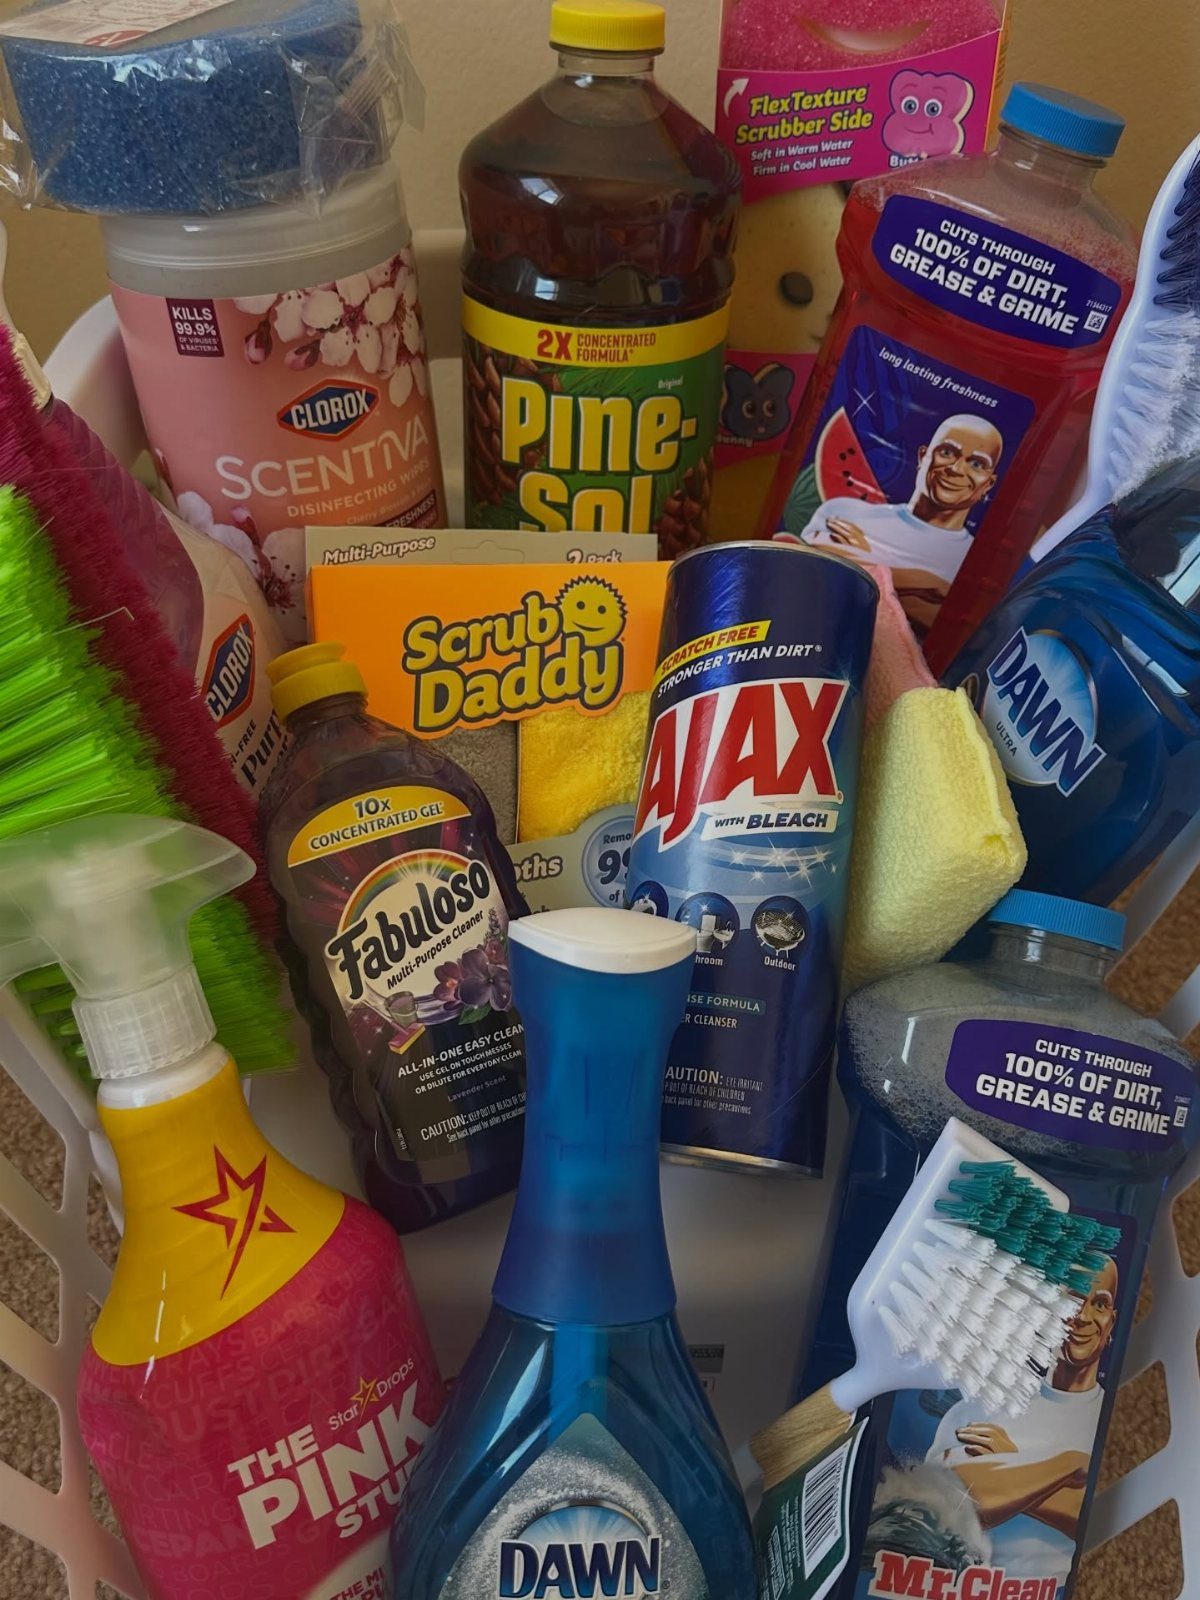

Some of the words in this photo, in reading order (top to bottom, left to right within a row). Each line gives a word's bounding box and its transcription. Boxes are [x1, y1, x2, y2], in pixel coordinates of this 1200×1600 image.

[736, 117, 826, 144] Scrubber
[829, 108, 873, 132] Side
[751, 147, 772, 161] Soft
[775, 147, 785, 157] in
[788, 144, 818, 156] Warm
[821, 140, 853, 152] Water
[753, 166, 776, 176] Firm
[780, 163, 790, 172] in
[793, 158, 816, 171] Cool
[820, 156, 851, 168] Water
[915, 227, 969, 269] 100%
[972, 255, 1006, 280] OF
[1007, 268, 1067, 309] DIRT,
[940, 219, 979, 246] CUTS
[981, 232, 1056, 275] THROUGH
[889, 243, 982, 297] GREASE
[977, 285, 996, 306] &
[998, 291, 1079, 335] GRIME
[172, 306, 212, 321] KILLS
[175, 322, 217, 336] 99.9%
[186, 344, 218, 352] BACTERIA
[537, 329, 573, 360] 2X
[577, 333, 656, 349] CONCENTRATED
[878, 347, 901, 370] long
[902, 359, 941, 387] lasting
[941, 376, 998, 409] freshness
[291, 389, 370, 431] CLOROX
[215, 415, 429, 501] SCENTIVA
[287, 479, 397, 518] DISINFECTING
[400, 459, 430, 485] WIPES
[323, 536, 436, 566] Multi-Purpose
[405, 594, 561, 669] Scrub
[661, 636, 715, 676] SCRATCH
[716, 626, 760, 646] FREE
[205, 623, 253, 722] CLOROX
[416, 635, 622, 731] Daddy
[657, 655, 724, 698] STRONGER
[726, 645, 773, 664] THAN
[988, 628, 1105, 795] DAWN
[996, 721, 1017, 757] ULTRA
[634, 681, 846, 846] AJAX
[355, 797, 392, 818] 10x
[714, 816, 744, 829] WITH
[746, 812, 828, 830] BLEACH
[310, 810, 418, 850] CONCENTRATED
[603, 832, 631, 845] Remo
[326, 861, 491, 1001] Fabuloso
[387, 936, 452, 990] Multi-Purpose
[452, 909, 484, 940] Cleaner
[695, 954, 723, 967] hroom
[764, 956, 796, 971] Outdoor
[694, 1014, 738, 1029] CLEANSER
[706, 996, 760, 1012] FORMULA
[398, 1045, 464, 1078] ALL-IN-ONE
[465, 1034, 492, 1053] EASY
[415, 1085, 427, 1095] OR
[427, 1076, 452, 1091] DILUTE
[452, 1070, 466, 1081] FOR
[466, 1057, 500, 1076] EVERYDAY
[501, 1049, 522, 1062] CLEAN
[419, 1071, 434, 1082] USE
[435, 1066, 450, 1076] GEL
[450, 1061, 461, 1071] ON
[483, 1041, 512, 1058] MESSES
[665, 1066, 724, 1085] AUTION:
[1035, 1039, 1082, 1061] CUTS
[1085, 1050, 1152, 1078] THROUGH
[448, 1085, 484, 1102] Lavender
[485, 1075, 506, 1088] Scent
[717, 1087, 745, 1101] CHILDREN
[1005, 1052, 1074, 1088] 100%
[1079, 1071, 1112, 1095] OF
[1114, 1079, 1162, 1111] DIRT,
[976, 1074, 1086, 1119] GREASE
[1088, 1101, 1104, 1124] &
[1108, 1106, 1171, 1135] GRIME
[420, 1113, 469, 1141] CAUTION:
[328, 1404, 360, 1431] Star
[376, 1358, 415, 1398] Drops
[227, 1424, 320, 1488] THE
[237, 1380, 436, 1550] PINK
[500, 1536, 661, 1600] DAWN
